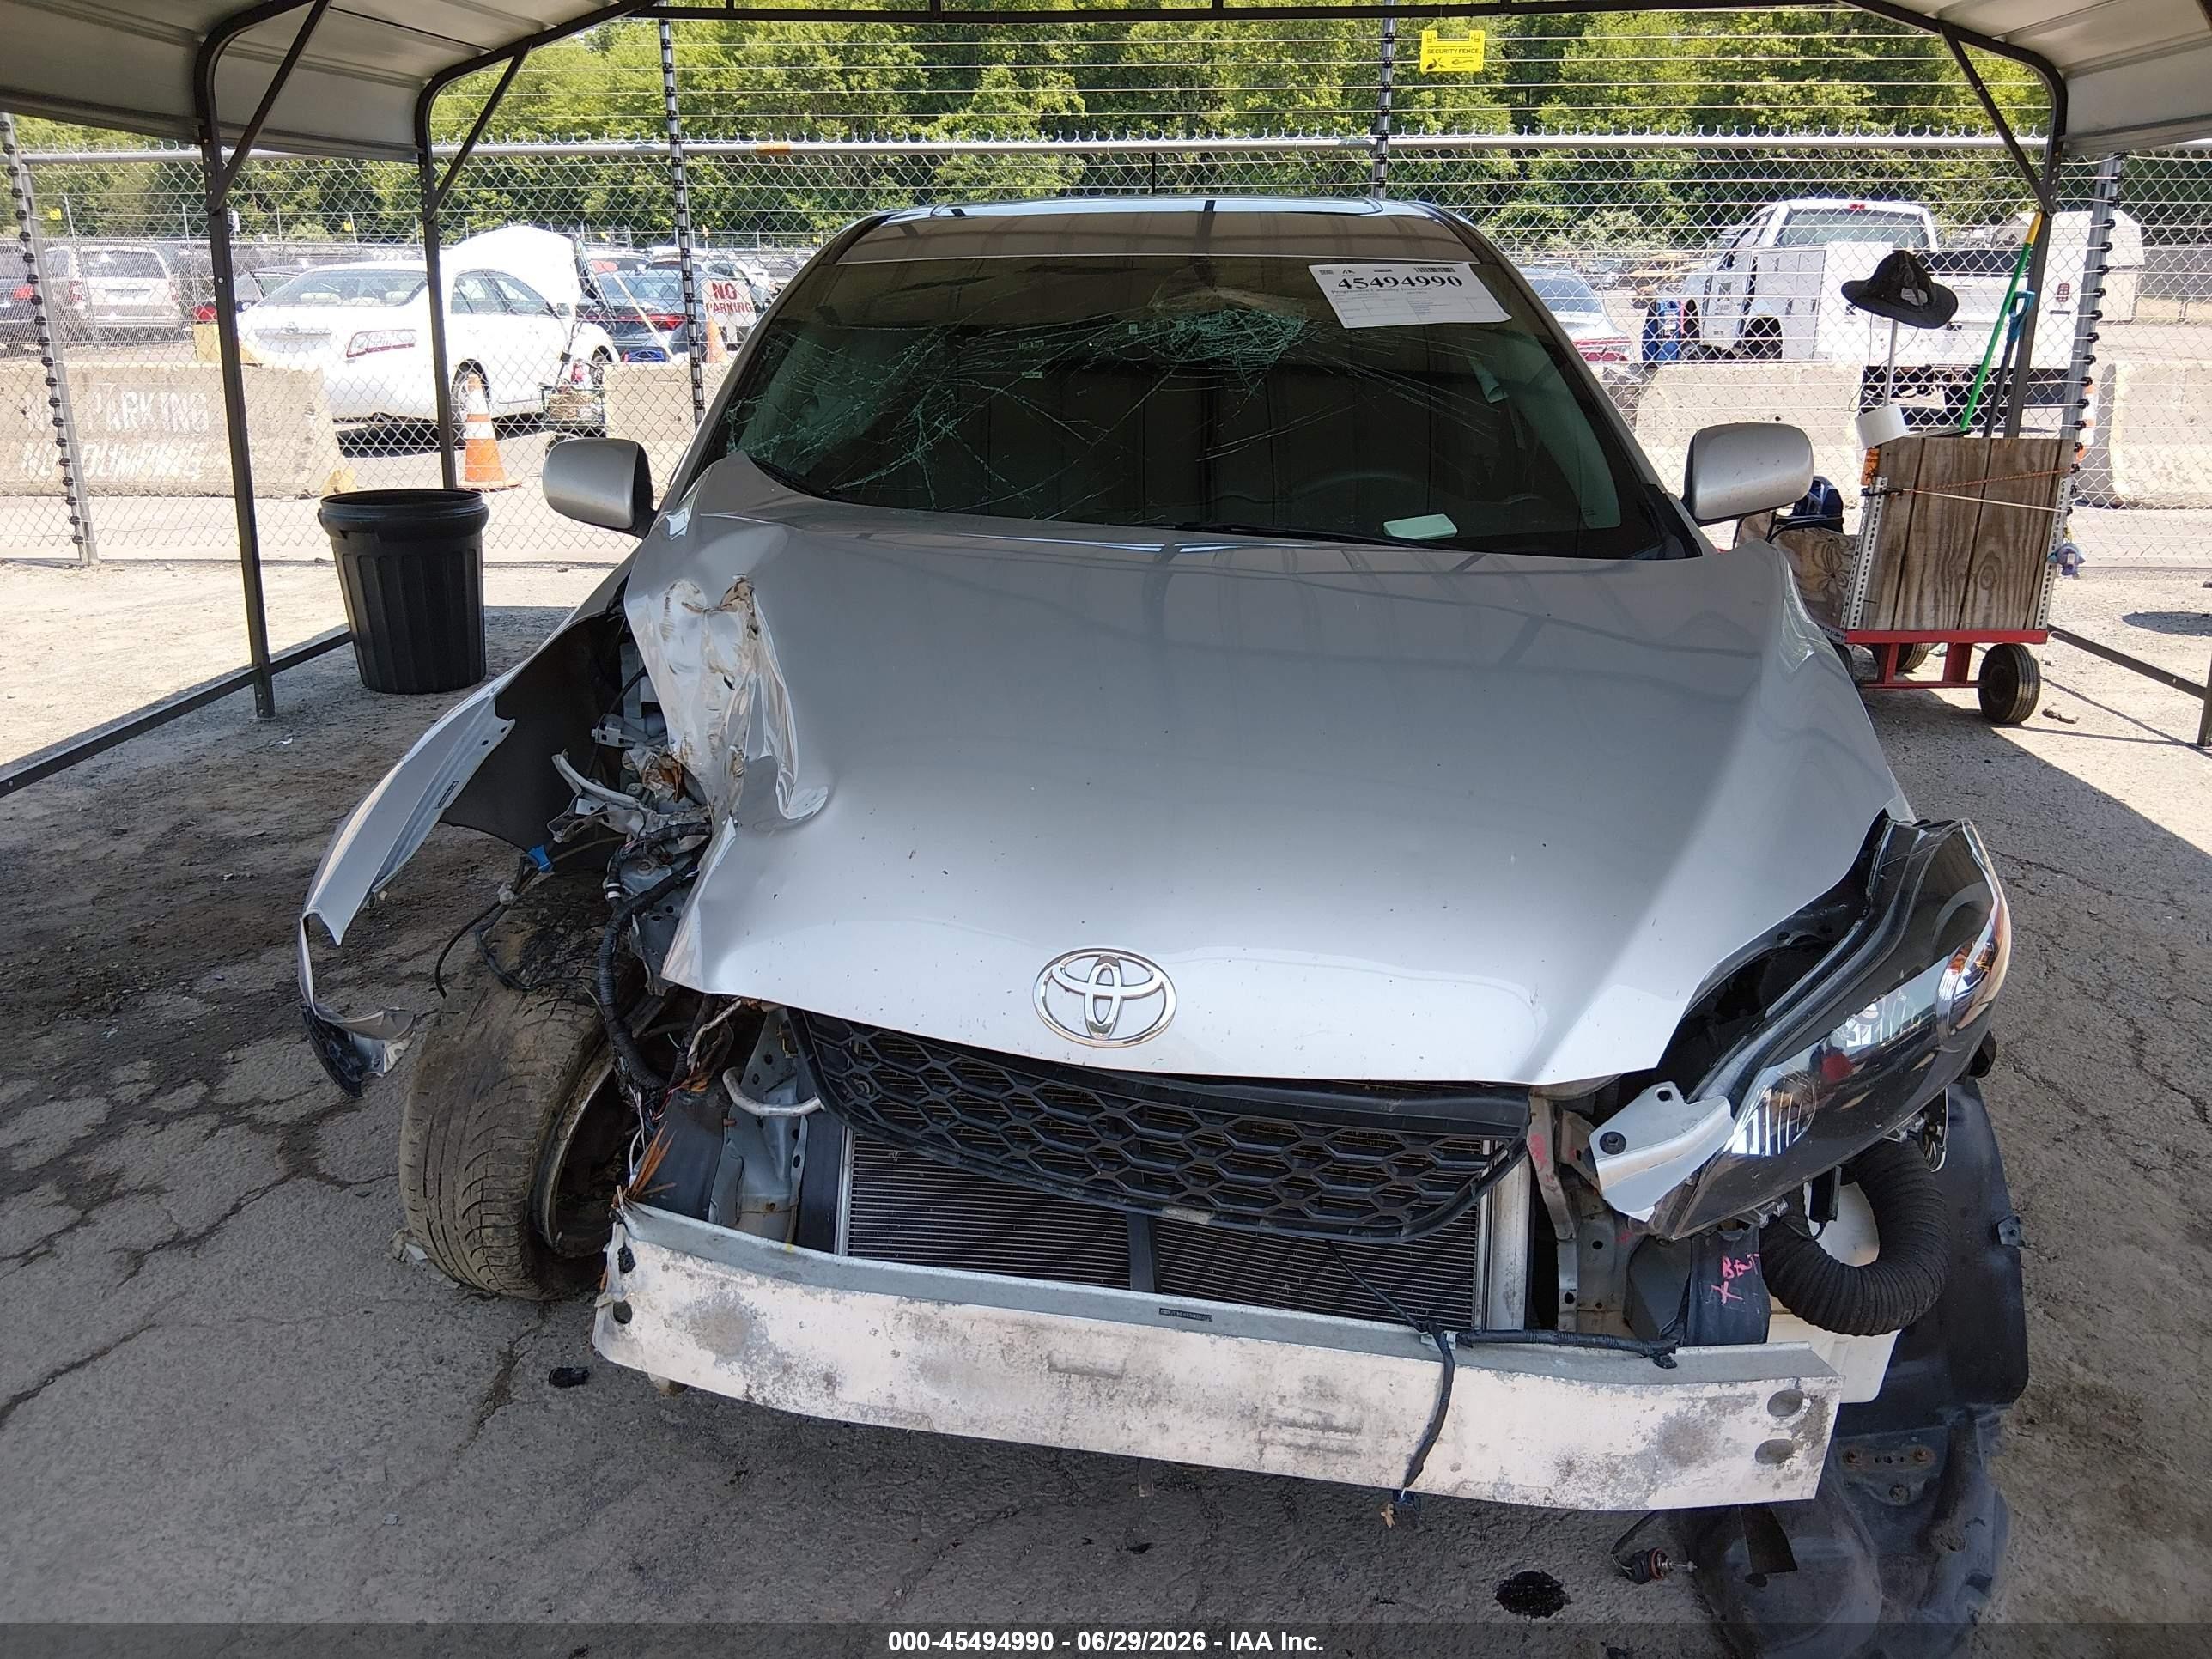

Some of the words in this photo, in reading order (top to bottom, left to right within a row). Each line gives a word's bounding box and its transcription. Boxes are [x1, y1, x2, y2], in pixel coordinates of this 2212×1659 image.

[1338, 276, 1463, 289] 45494990
[712, 283, 738, 300] NO
[706, 301, 752, 313] PARKING
[84, 386, 210, 434] PARKING
